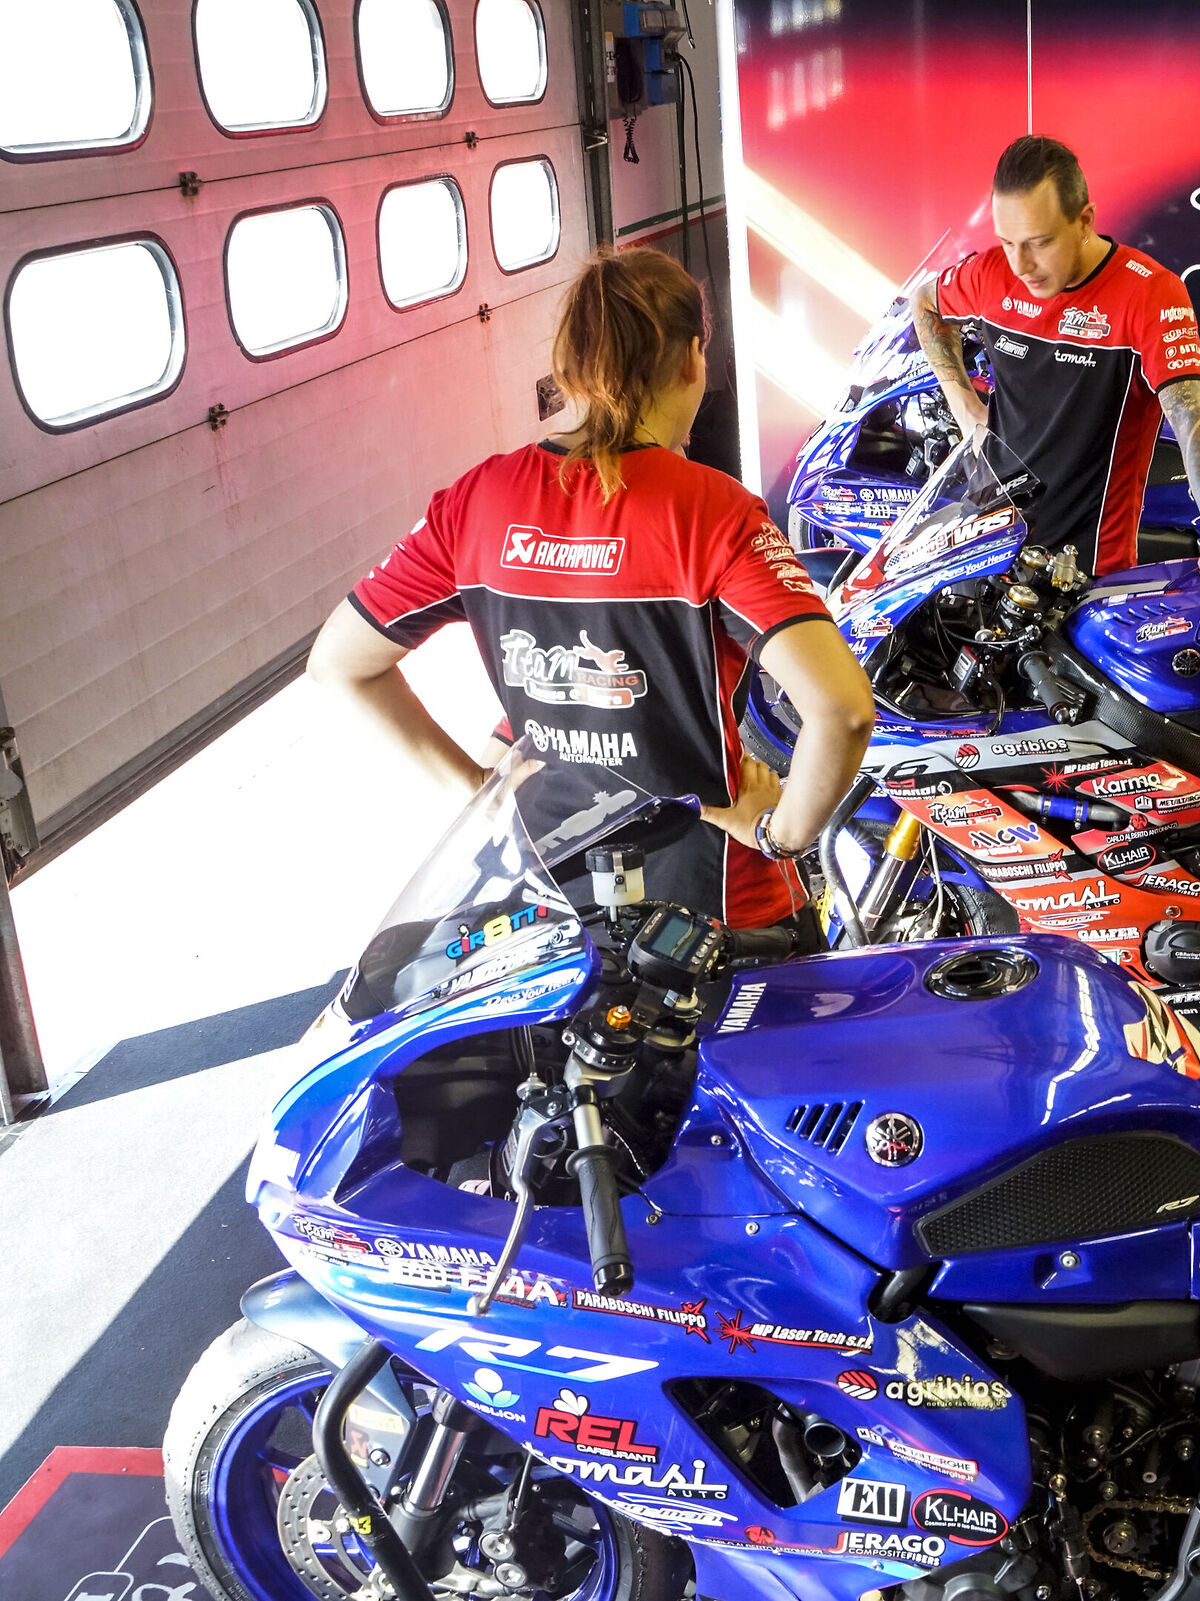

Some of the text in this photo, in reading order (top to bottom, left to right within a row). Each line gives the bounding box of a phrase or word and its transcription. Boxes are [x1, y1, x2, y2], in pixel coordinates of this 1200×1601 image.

[954, 509, 1013, 544] WRS
[534, 541, 617, 569] AKRAPOVIČ
[502, 636, 574, 682] Team
[576, 673, 639, 687] RACING
[544, 725, 638, 758] YAMAHA
[991, 739, 1068, 756] agribios
[559, 752, 623, 767] AUTOMASTER
[1064, 764, 1077, 774] MP
[1077, 763, 1098, 773] Laser
[1092, 772, 1161, 796] Karma
[929, 802, 967, 821] Team
[984, 860, 1068, 878] PARABOSCHI FILIPPO
[1104, 846, 1150, 868] KLHAIR
[1085, 898, 1121, 910] AUTO
[1077, 926, 1140, 939] GALFER
[717, 982, 767, 1034] YAMAHA
[293, 1215, 334, 1240] Team
[402, 1241, 496, 1267] YAMAHA
[576, 1290, 707, 1328] PARABOSCHI FILIPPO
[750, 1323, 772, 1337] MP
[773, 1326, 810, 1342] Laser
[811, 1329, 846, 1346] Tech
[415, 1328, 660, 1383] R7
[885, 1374, 1004, 1407] agribios
[535, 1407, 657, 1455] REL
[577, 1444, 656, 1463] CARBURANTI
[667, 1488, 726, 1499] AUTO
[925, 1496, 997, 1529] KLHAIR
[828, 1532, 946, 1558] JERAGO
[848, 1547, 942, 1567] COMPOSITEFIBERS
